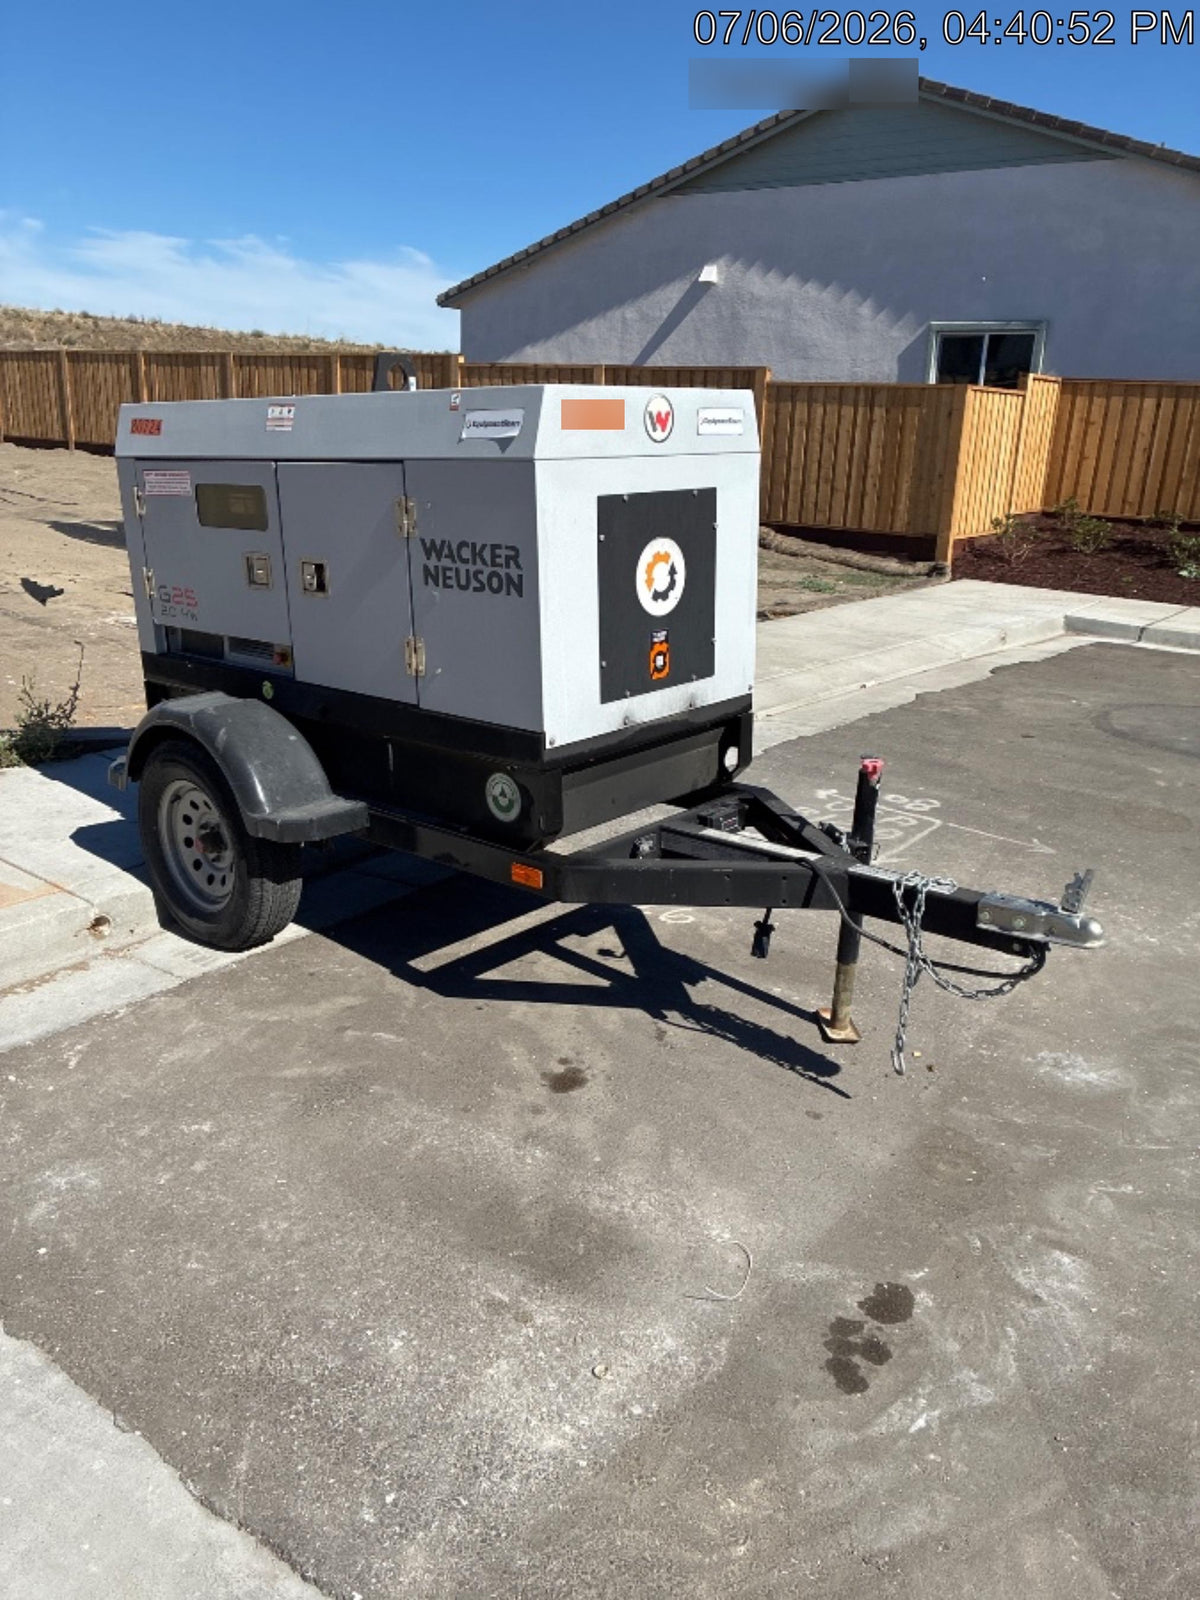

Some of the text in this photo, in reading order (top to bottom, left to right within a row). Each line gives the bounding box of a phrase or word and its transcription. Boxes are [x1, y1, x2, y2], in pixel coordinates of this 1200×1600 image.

[419, 537, 523, 571] WACKER
[158, 585, 198, 607] G25
[423, 563, 523, 598] NEUSON
